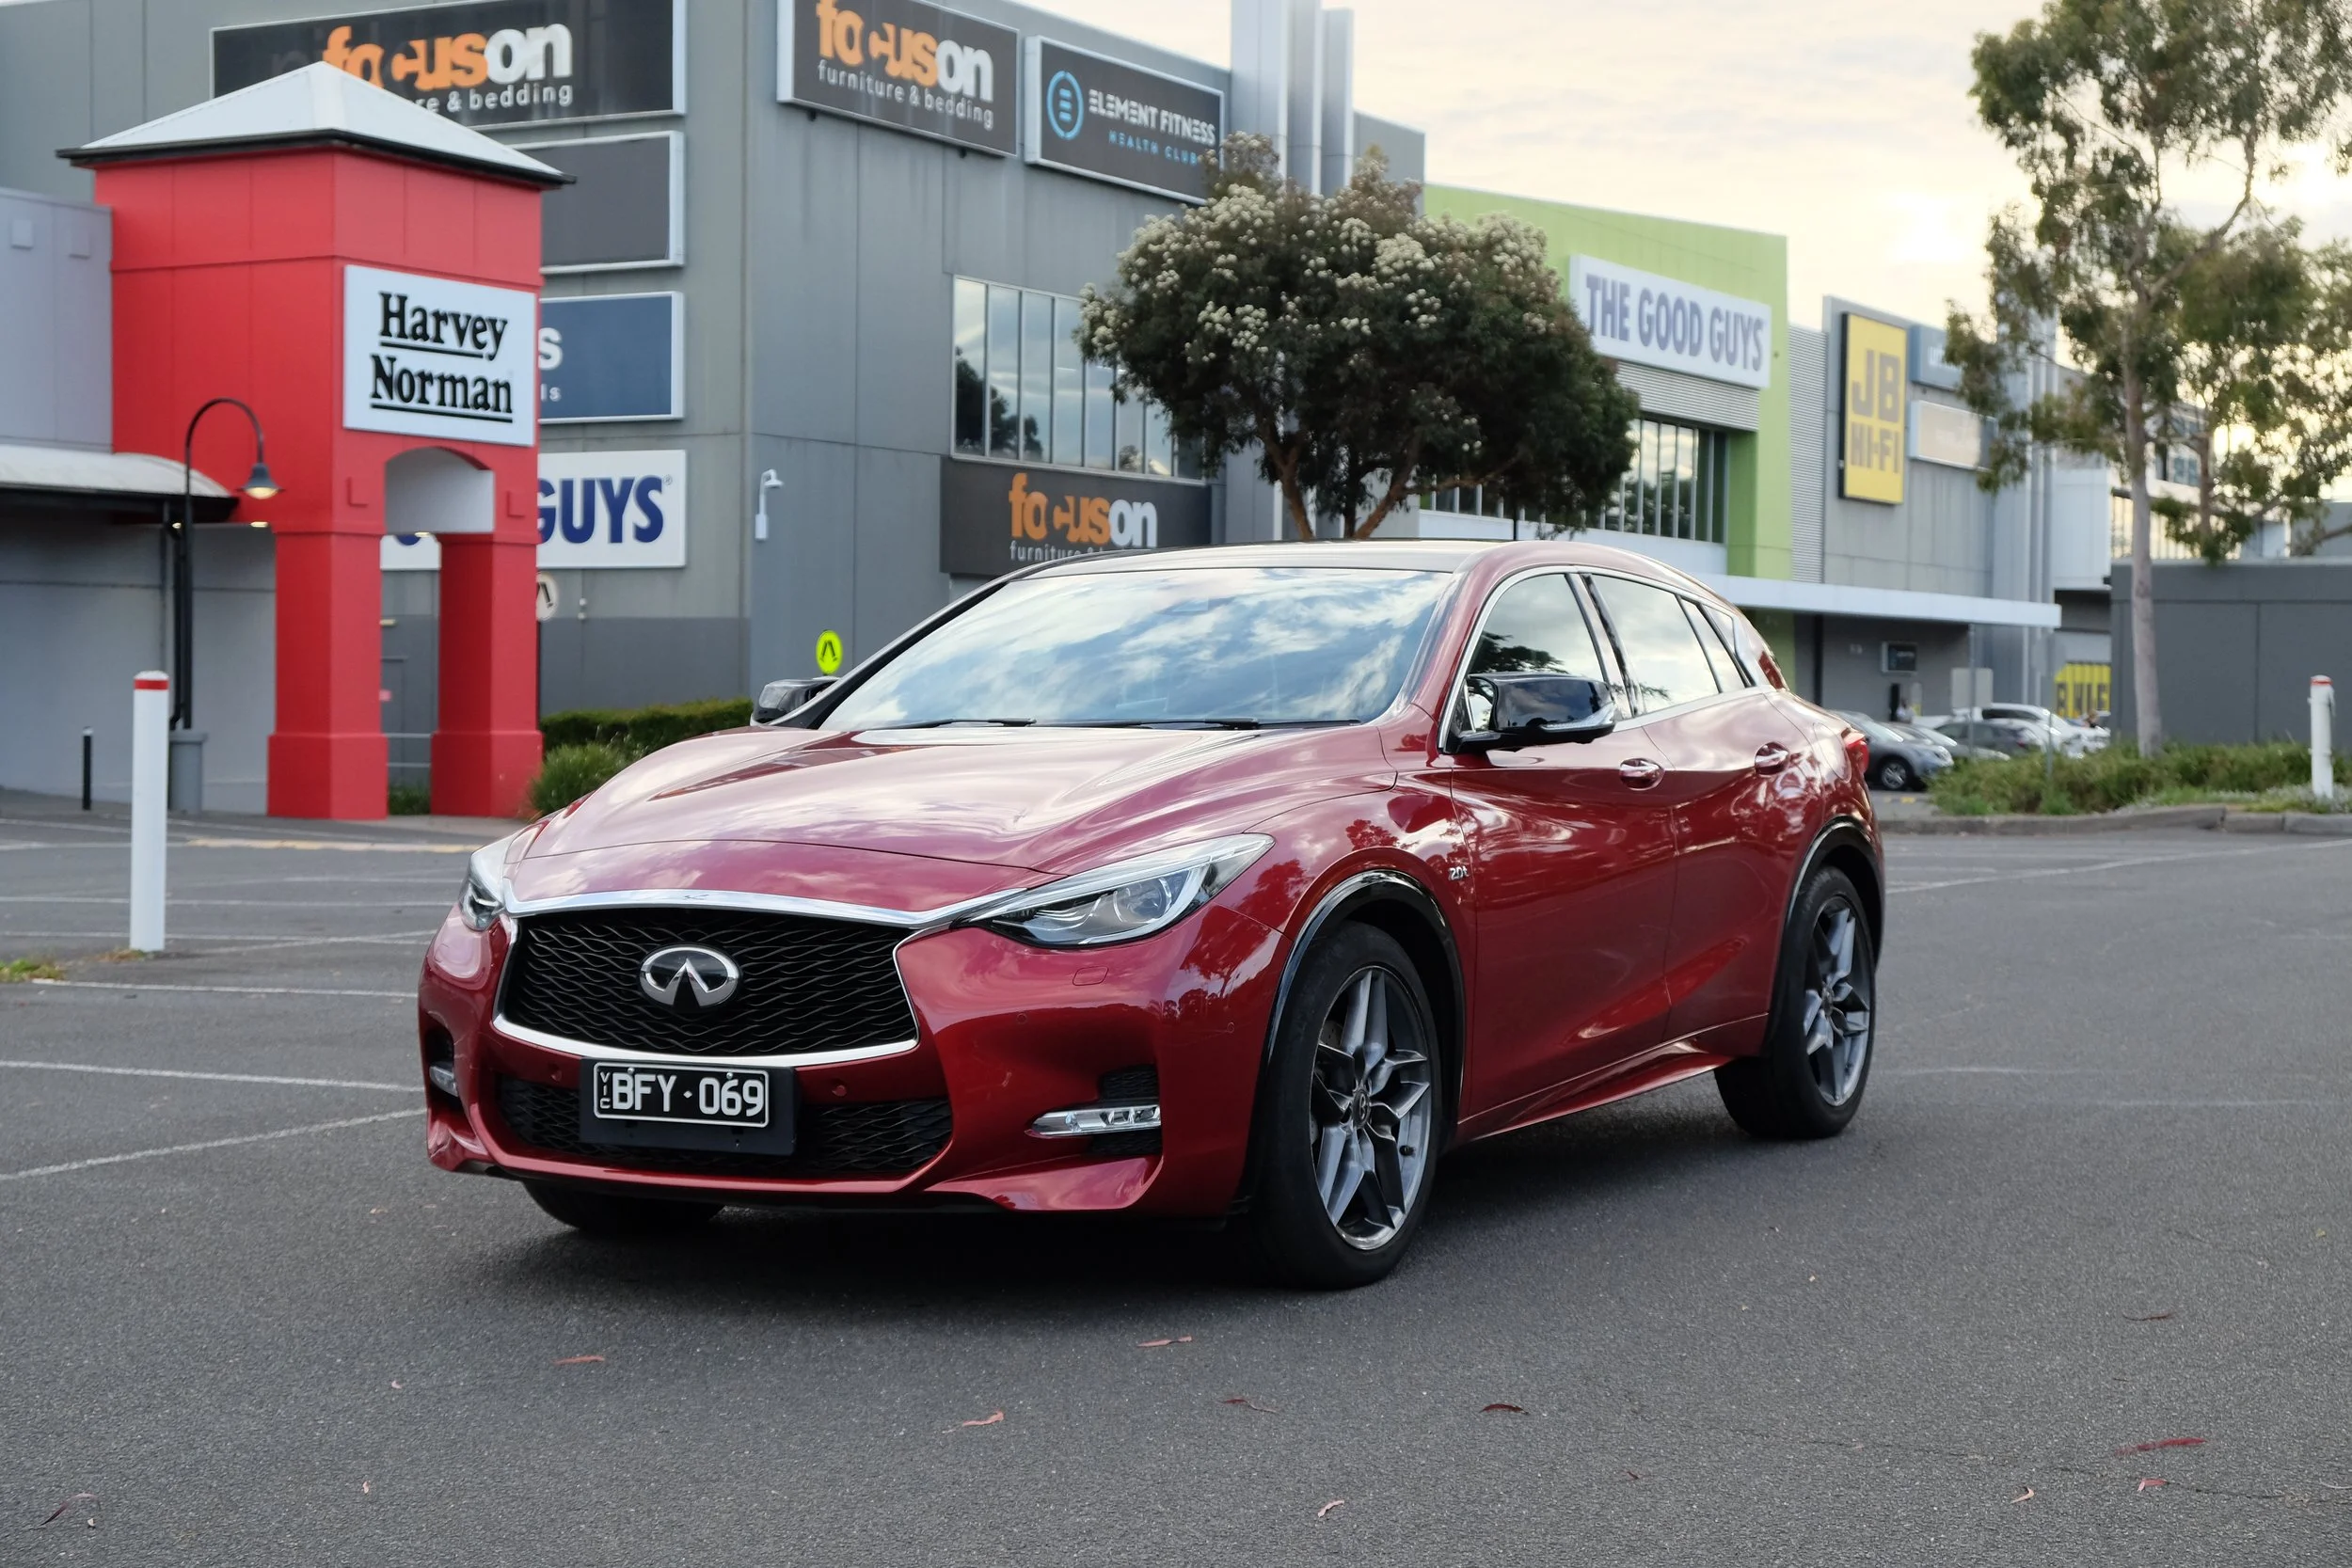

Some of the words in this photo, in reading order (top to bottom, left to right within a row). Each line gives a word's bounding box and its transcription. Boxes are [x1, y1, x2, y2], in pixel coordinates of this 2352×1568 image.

[816, 0, 994, 103] focuson
[469, 84, 573, 111] bedding
[817, 58, 906, 103] furniture
[909, 85, 921, 107] &
[924, 87, 994, 131] bedding
[1089, 88, 1159, 130] ELEMENT
[1159, 109, 1216, 147] FITNESS
[1109, 130, 1159, 155] HEALTH
[1164, 145, 1199, 166] CLUB
[379, 291, 508, 361] Harvey
[1586, 274, 1630, 341] THE
[1638, 287, 1705, 357] GOOD
[1709, 305, 1765, 372] GUYS
[370, 353, 513, 413] Norman
[1851, 349, 1901, 423] JB
[1850, 421, 1900, 474] HI-FI
[1009, 472, 1158, 548] focuson
